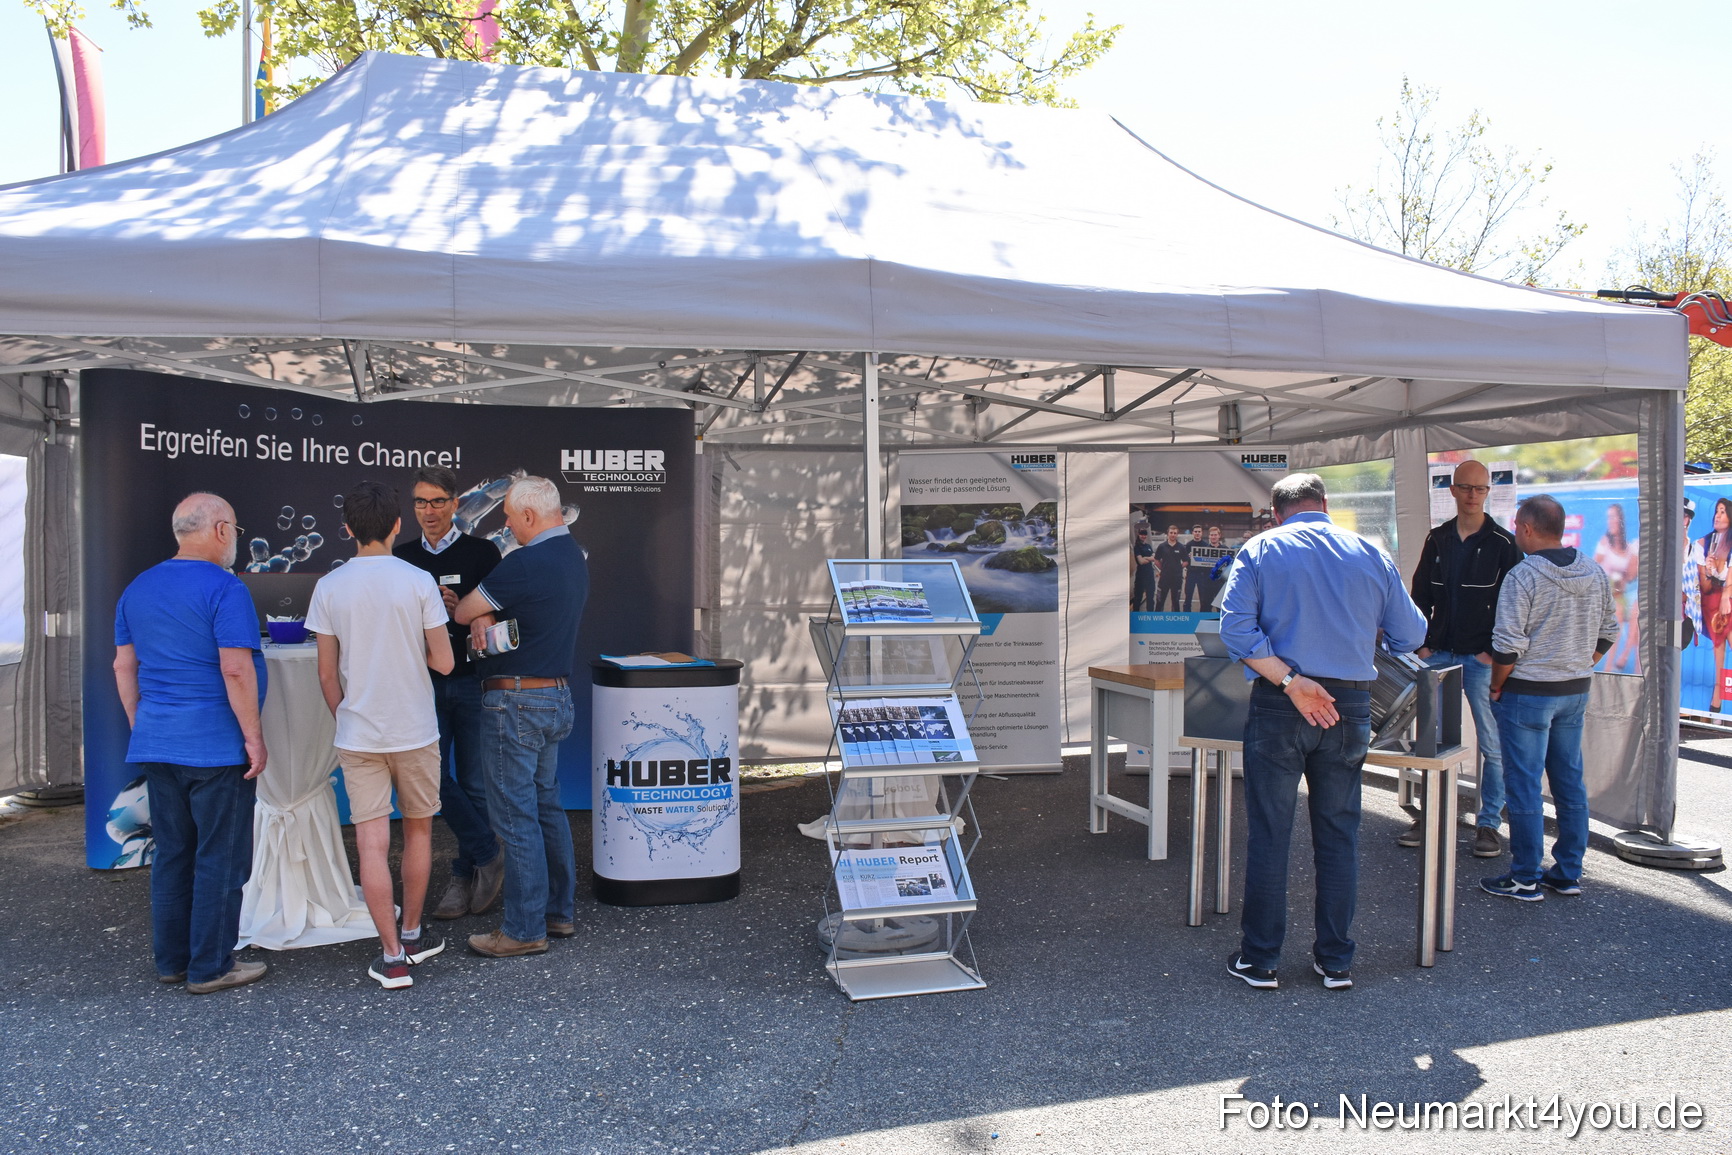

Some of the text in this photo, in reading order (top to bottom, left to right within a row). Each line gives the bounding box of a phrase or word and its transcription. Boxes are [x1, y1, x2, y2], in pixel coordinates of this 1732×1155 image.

[141, 423, 461, 469] Ergreifen Sie Ihre Chance!
[561, 449, 665, 471] HUBER
[1011, 454, 1056, 464] HUBER
[1241, 454, 1287, 463] HUBER
[583, 473, 661, 482] TECHNOLOGY
[934, 477, 953, 485] findet
[969, 476, 1007, 485] geeigneten
[1155, 476, 1182, 484] Einstieg
[633, 485, 661, 493] Solutions
[953, 485, 985, 494] passende
[987, 485, 1011, 493] Lösung
[1193, 548, 1236, 559] HUBER
[607, 757, 732, 787] HUBER
[631, 786, 729, 801] TECHNOLOGY
[633, 806, 663, 815] WASTE
[665, 805, 695, 814] WATER
[855, 856, 897, 867] HUBER
[899, 854, 940, 866] Report
